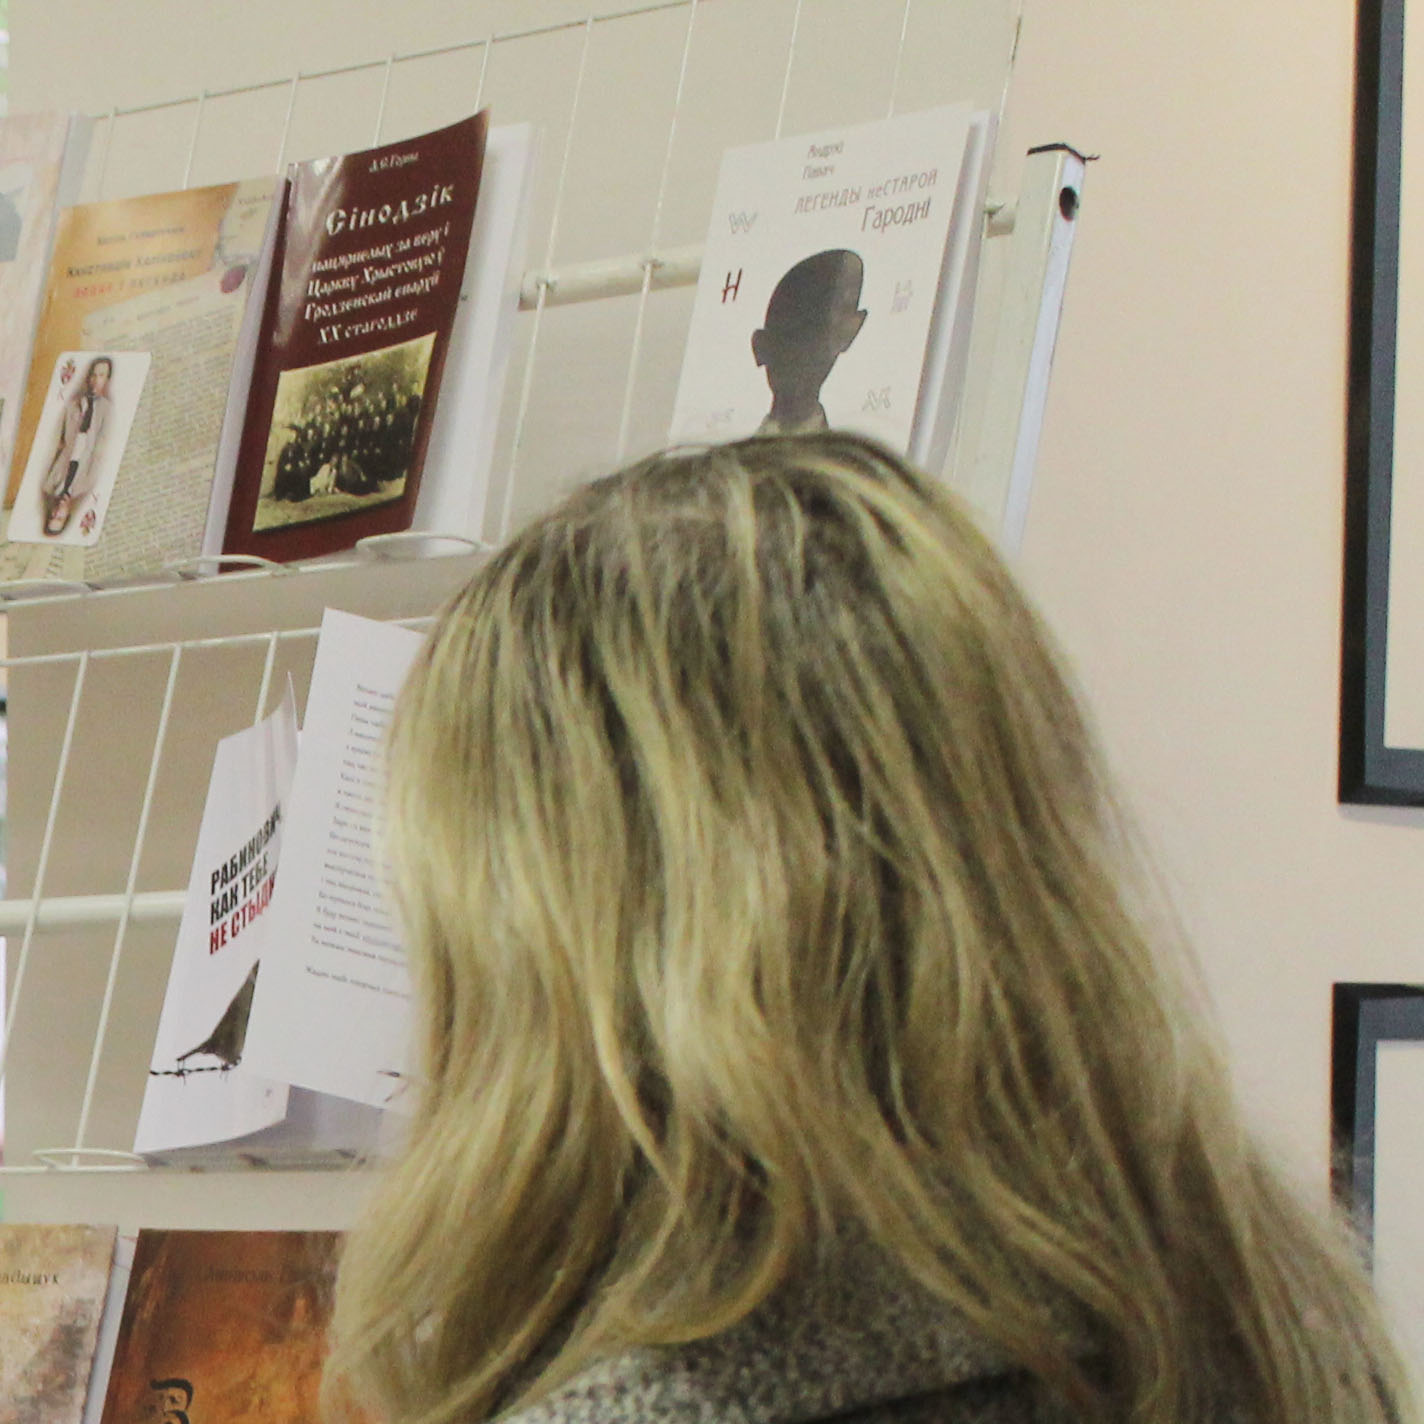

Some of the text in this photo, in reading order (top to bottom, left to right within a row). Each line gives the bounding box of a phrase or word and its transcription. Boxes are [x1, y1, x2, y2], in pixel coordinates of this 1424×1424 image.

[326, 184, 455, 236] Сінодзік
[794, 186, 863, 214] ЛЕГЕНДЫ
[861, 196, 932, 233] Гародні
[210, 851, 269, 926] КАК ТЕБЕ
[210, 921, 227, 956] НЕ
